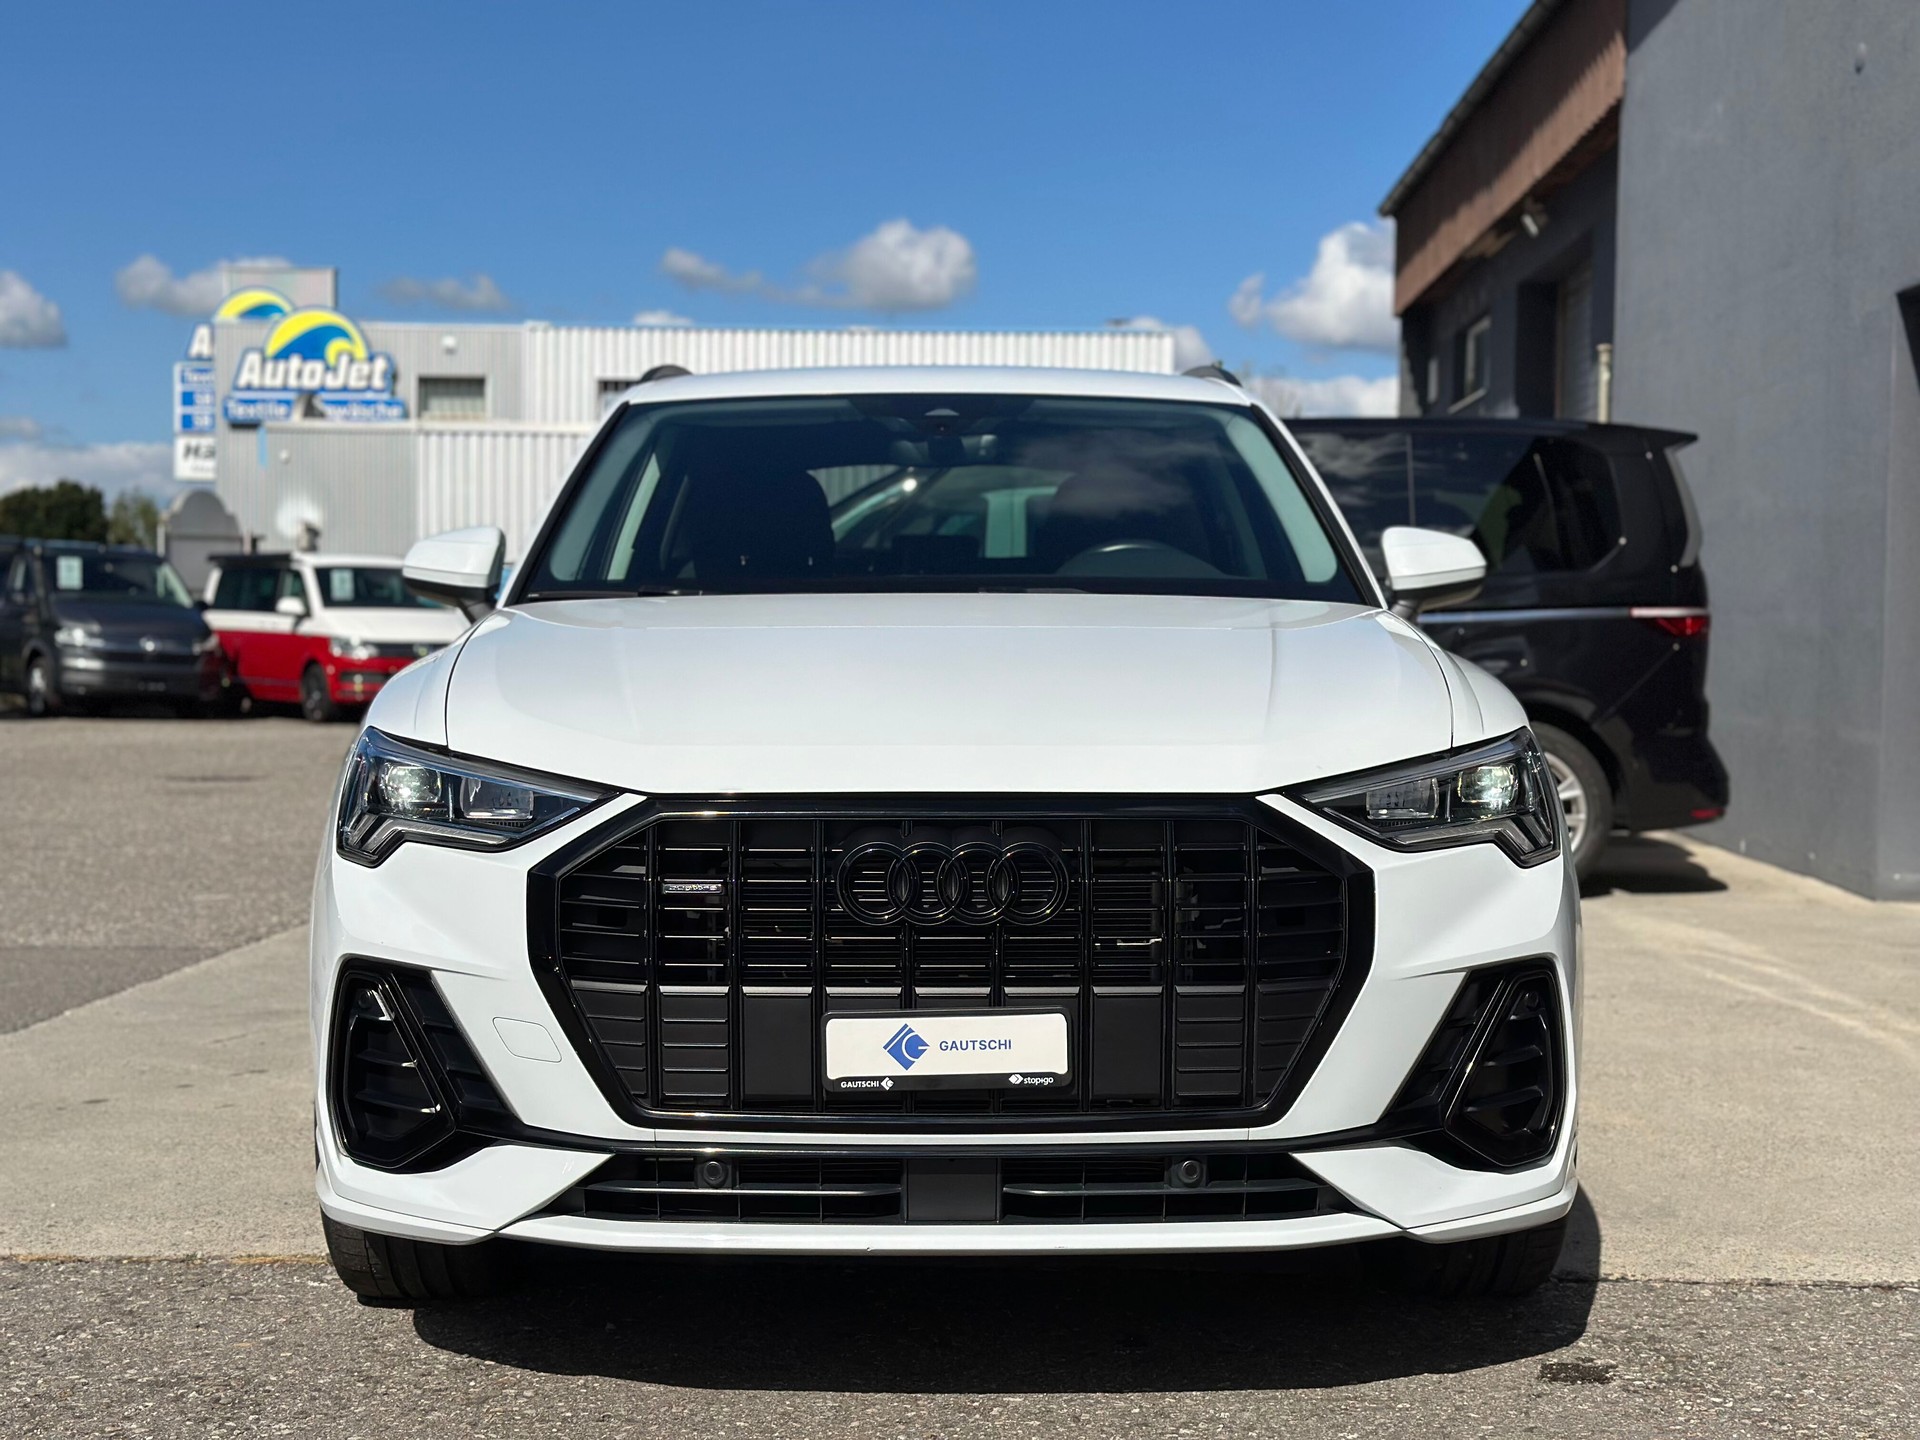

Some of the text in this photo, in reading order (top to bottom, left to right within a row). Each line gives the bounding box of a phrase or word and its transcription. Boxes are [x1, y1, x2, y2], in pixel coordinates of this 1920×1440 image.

[237, 351, 387, 390] AutoJet
[939, 1039, 1012, 1051] GAUTSCHI
[840, 1080, 880, 1088] GAUTSCHI
